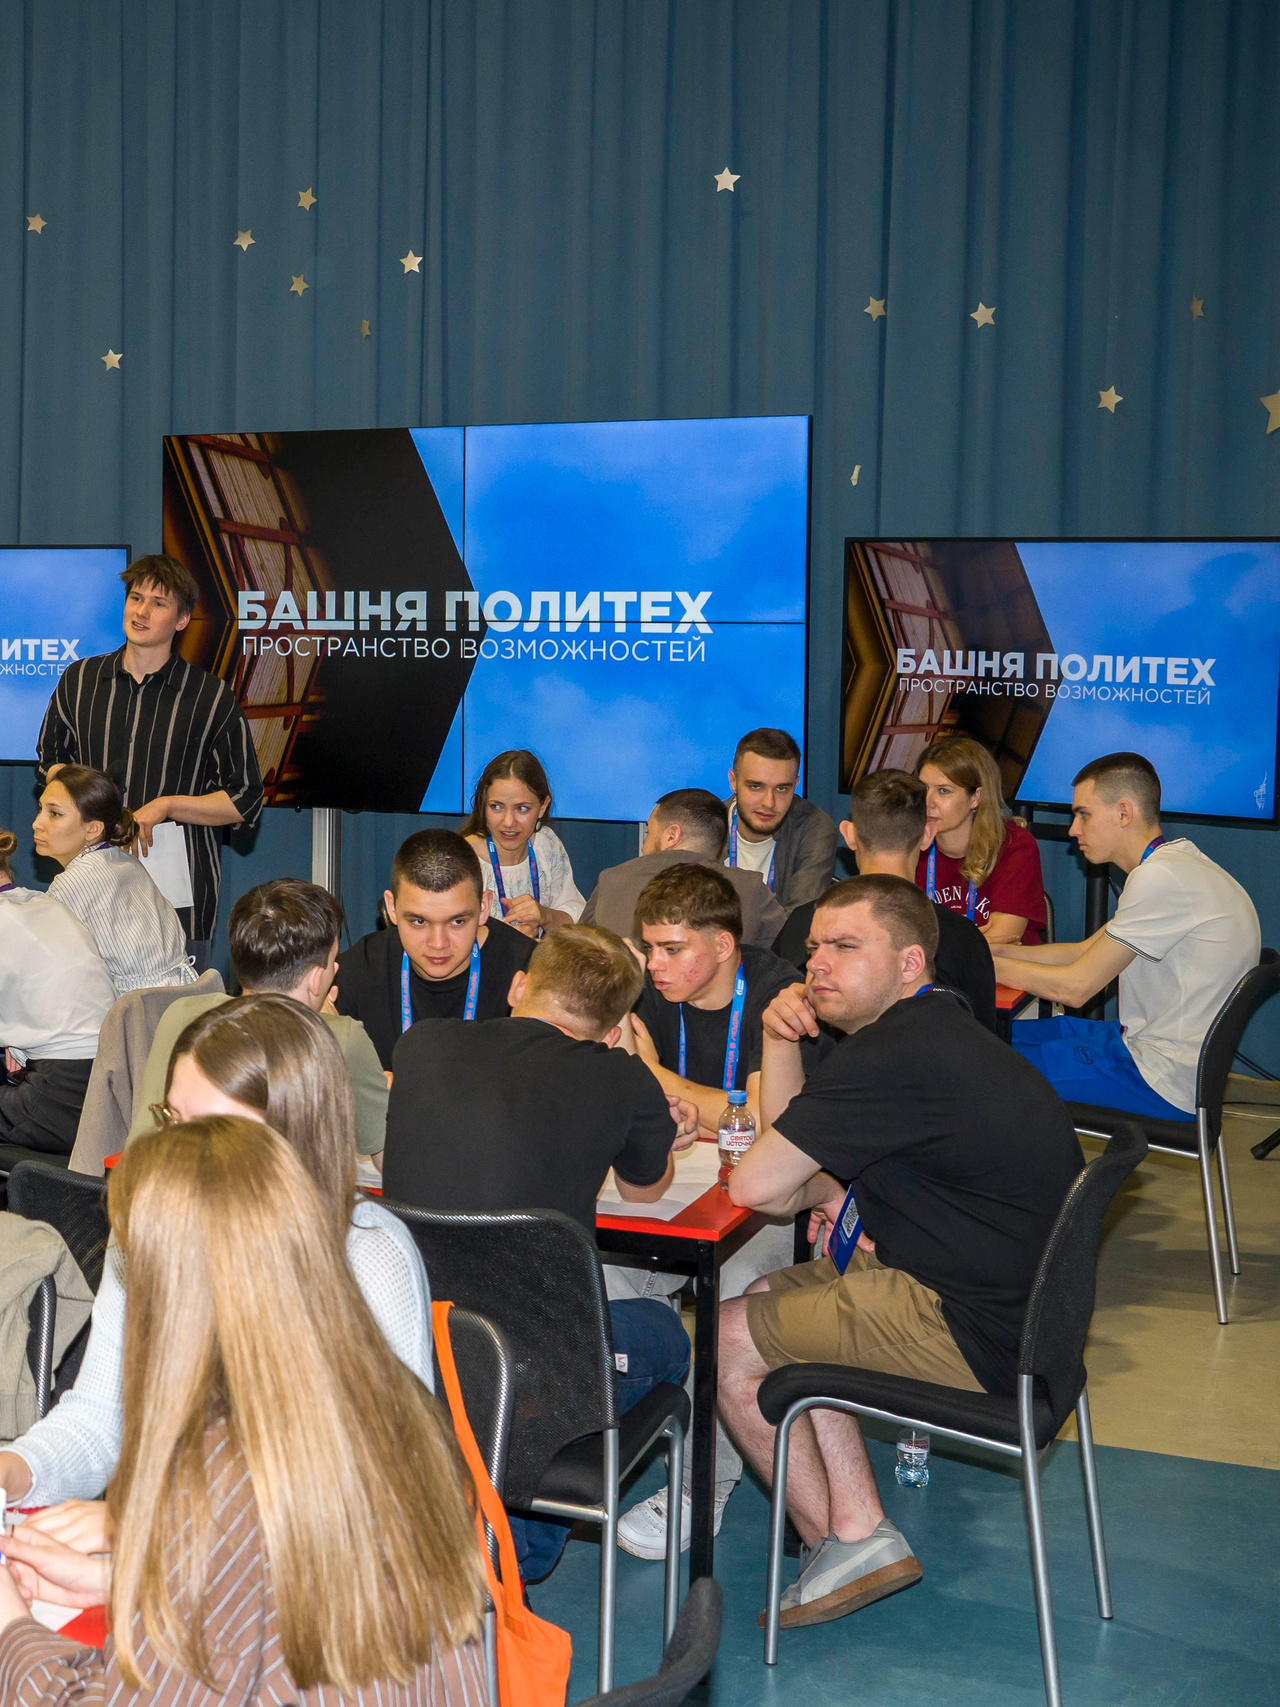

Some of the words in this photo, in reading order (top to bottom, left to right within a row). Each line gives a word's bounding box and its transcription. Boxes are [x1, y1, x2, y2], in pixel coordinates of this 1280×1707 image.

[238, 590, 427, 632] БАШНЯ
[445, 590, 714, 634] ПОЛИТЕХ
[242, 636, 450, 659] ПРОСТРАНСТВО
[460, 635, 706, 663] ВОЗМОЖНОСТЕЙ
[896, 648, 1025, 679] БАШНЯ
[1036, 652, 1216, 686] ПОЛИТЕХ
[898, 677, 1039, 698] ПРОСТРАНСТВО
[1045, 684, 1211, 705] ВОЗМОЖНОСТЕЙ
